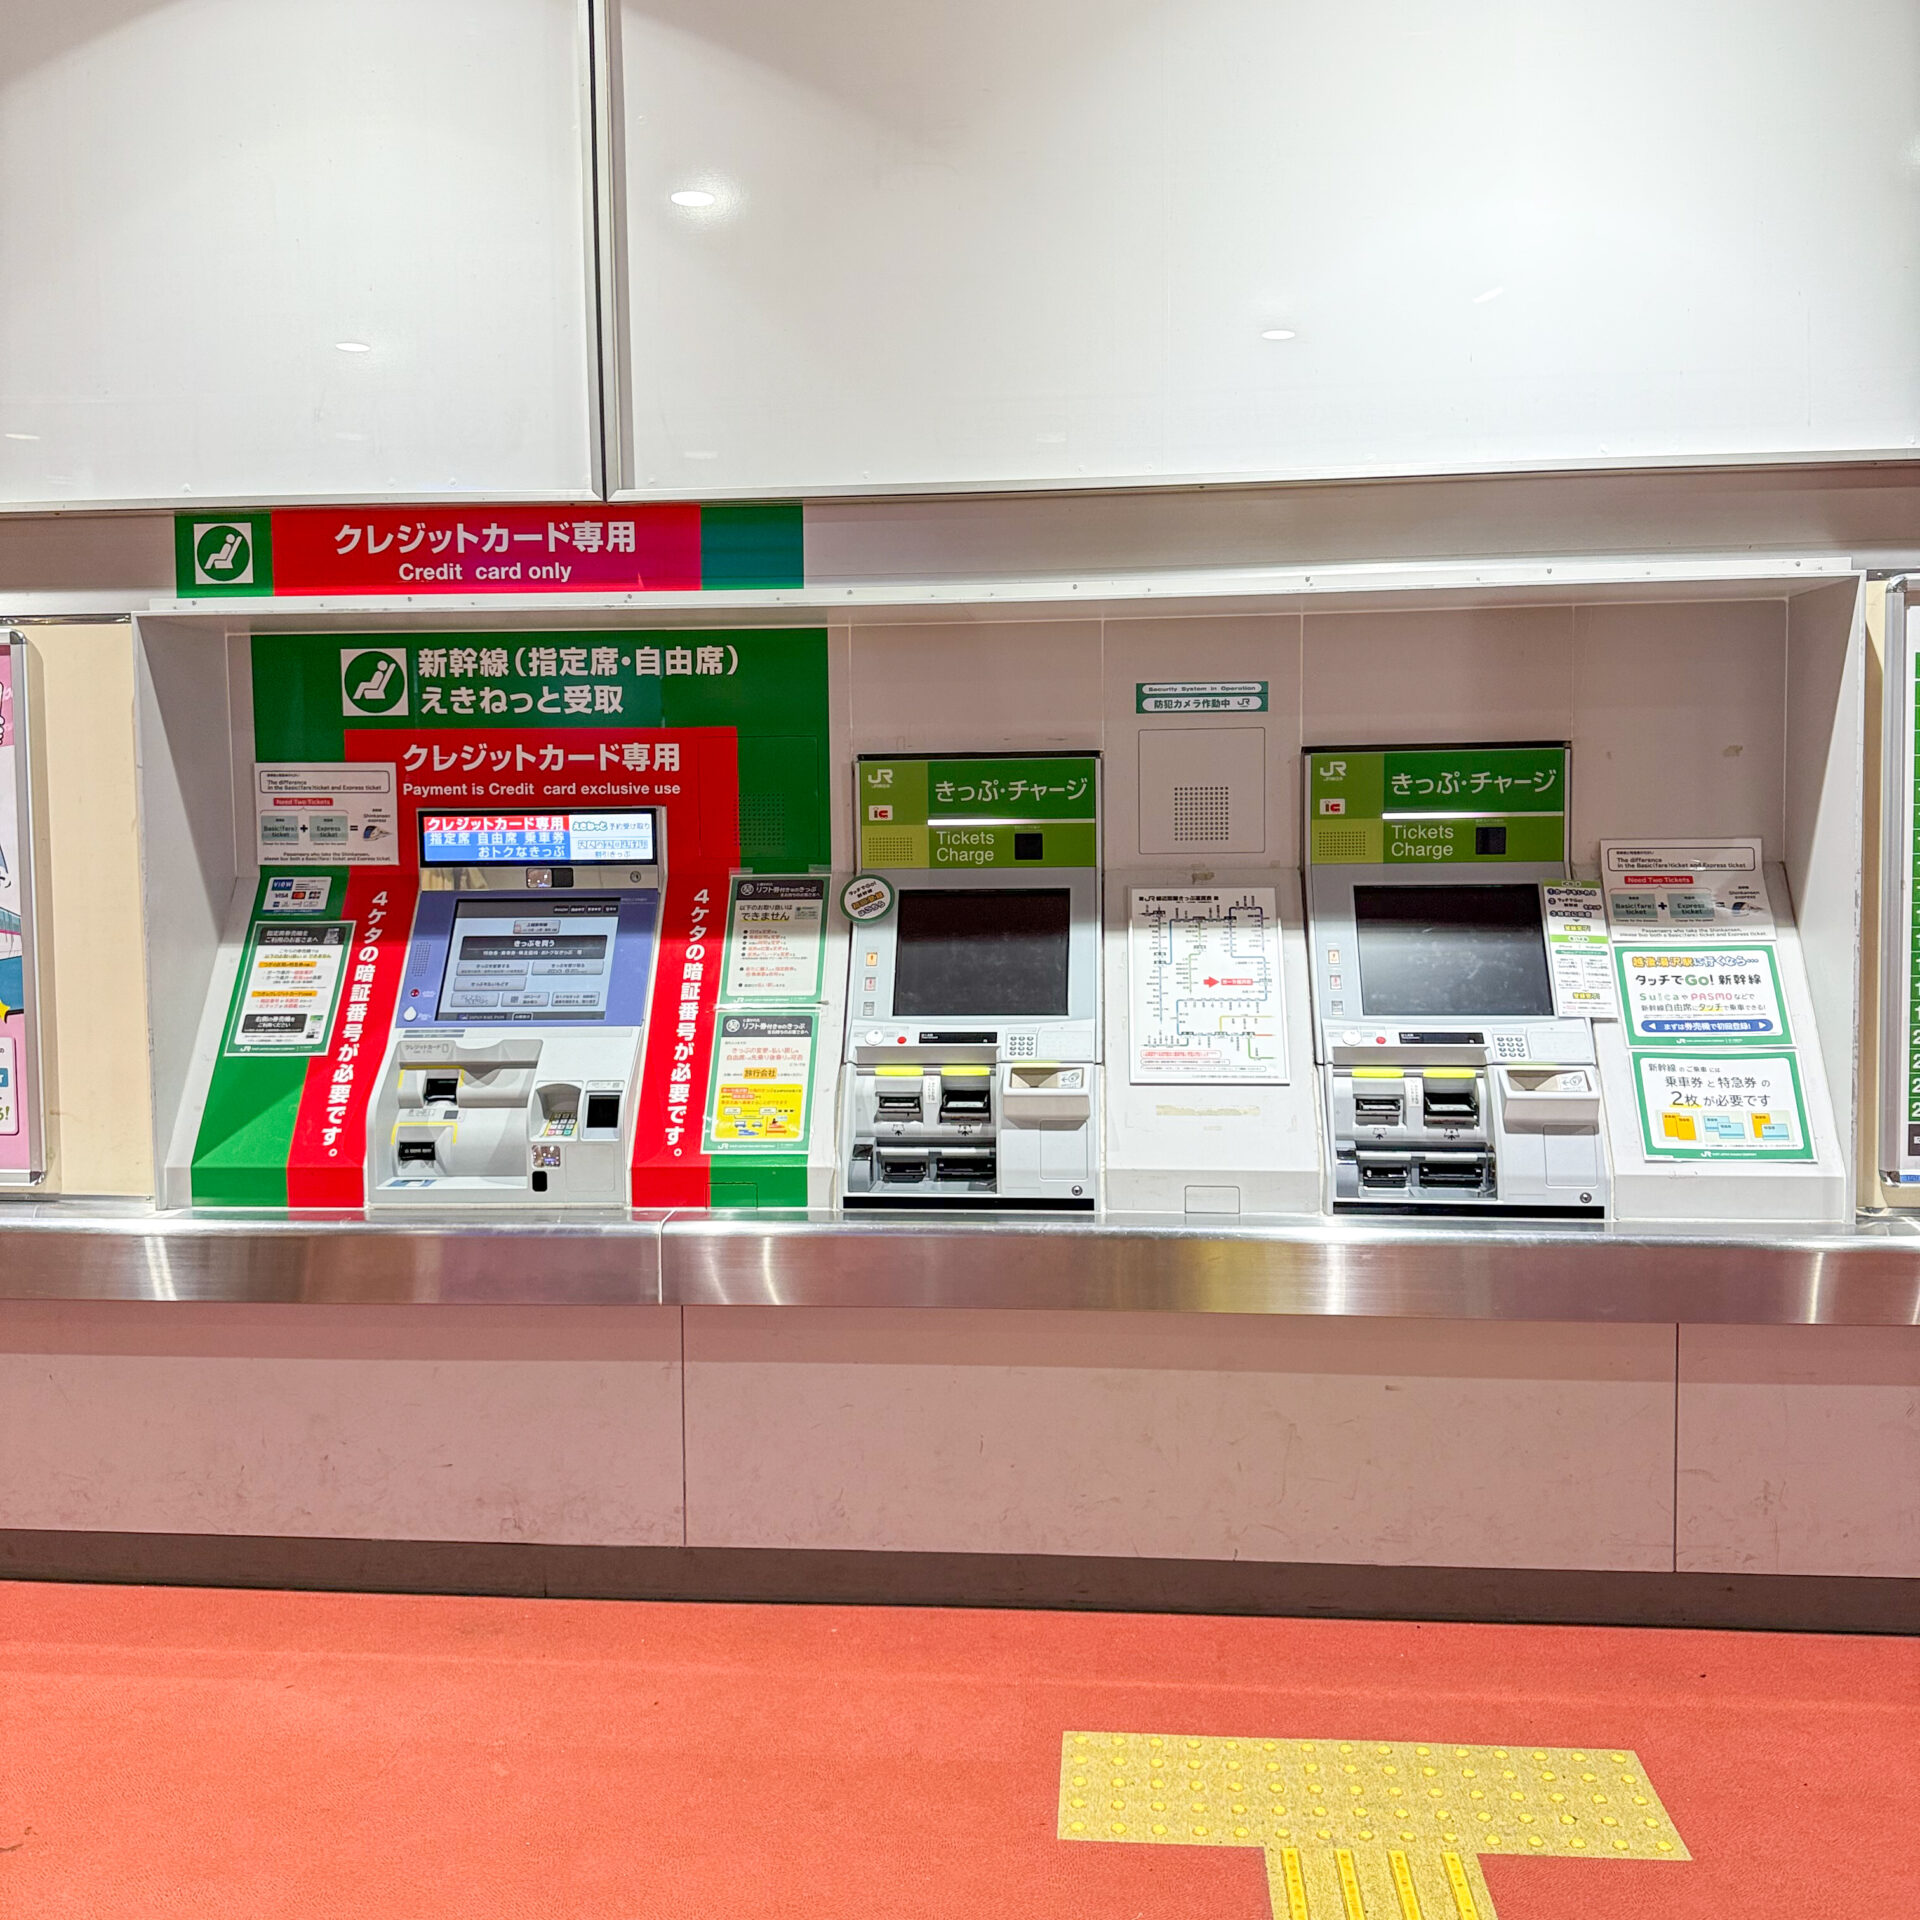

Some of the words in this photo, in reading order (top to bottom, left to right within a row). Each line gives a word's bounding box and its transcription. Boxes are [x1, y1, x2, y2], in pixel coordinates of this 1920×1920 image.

[335, 521, 636, 554] クレジットカード専用
[398, 563, 462, 581] Credit
[475, 562, 521, 580] card
[528, 562, 572, 582] only
[418, 645, 739, 677] 新幹線（指定席・自由席）
[421, 685, 624, 714] えきねっと受取
[1154, 699, 1230, 709] 防犯カメラ作動中
[402, 743, 680, 772] クレジットカード専用
[868, 769, 893, 784] JR
[1320, 761, 1347, 776] JR
[403, 783, 467, 798] Payment
[472, 783, 484, 795] is
[489, 782, 535, 796] Credit
[543, 782, 576, 795] card
[581, 782, 650, 795] exclusive
[654, 785, 681, 795] use
[935, 777, 1088, 802] きっぷ・チャージ
[1391, 769, 1557, 795] きっぷ・チャージ
[428, 817, 564, 831] クレジットカード専用
[429, 832, 470, 845] 指定席
[477, 832, 519, 845] 自由席
[524, 832, 565, 844] 乗車券
[936, 831, 995, 845] Tickets
[1391, 825, 1454, 840] Tickets
[478, 845, 565, 858] おトクなきっぷ
[936, 848, 994, 865] Charge
[1391, 842, 1454, 860] Charge
[742, 912, 790, 921] できません
[1665, 1076, 1771, 1089] 乗車券と特急券の
[1672, 1091, 1771, 1107] 2枚が必要です
